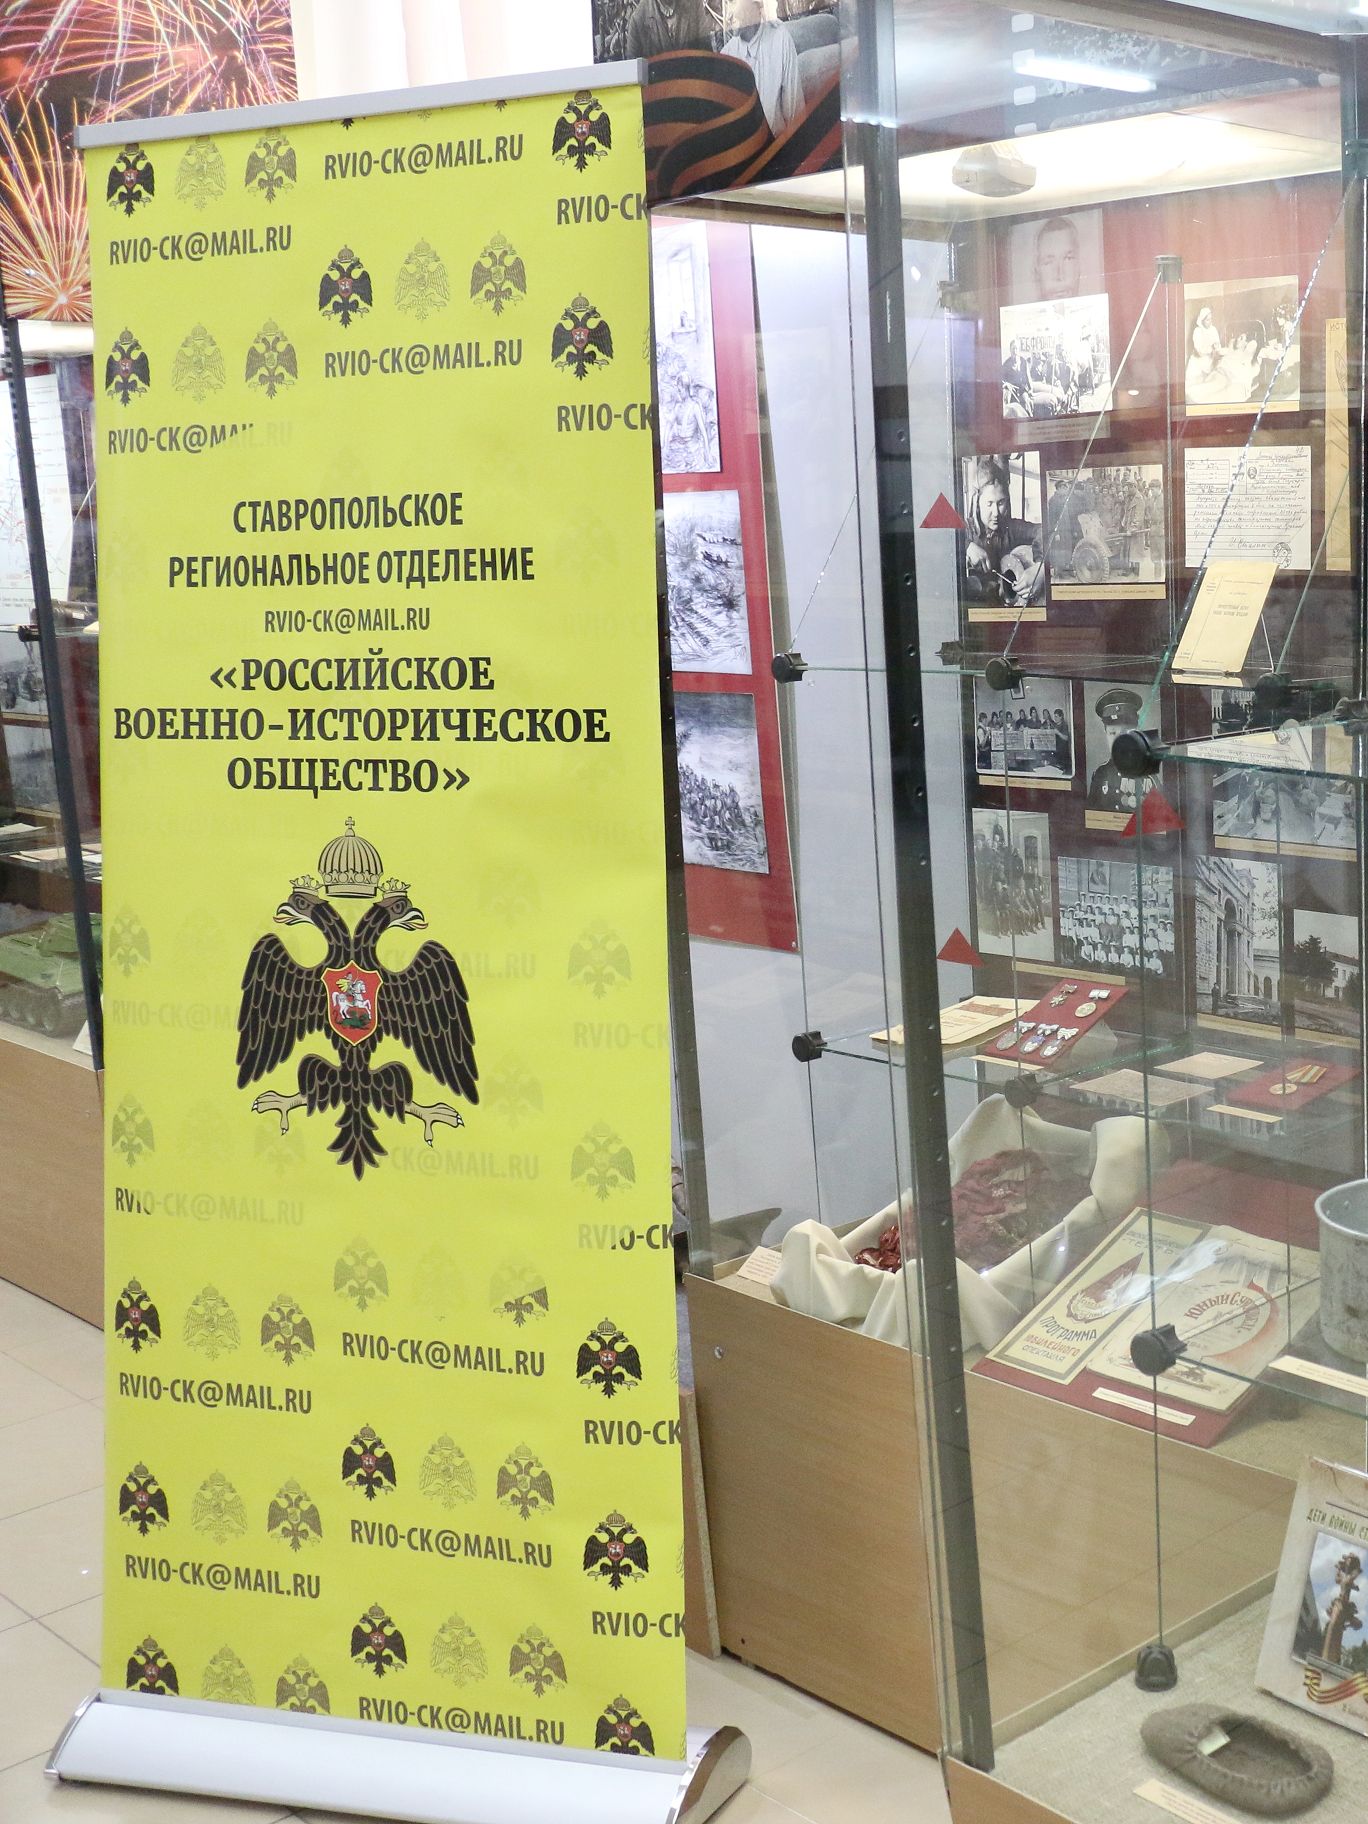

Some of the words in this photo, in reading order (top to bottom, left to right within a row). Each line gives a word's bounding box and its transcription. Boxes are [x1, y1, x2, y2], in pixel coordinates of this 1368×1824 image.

[324, 134, 524, 180] RVIO-CK@MAIL.RU
[109, 225, 292, 265] RVIO-CK@MAIL.RU
[324, 339, 523, 378] RVIO-CK@MAIL.RU
[233, 492, 463, 534] СТАВРОПОЛЬСКОЕ
[168, 551, 371, 588] РЕГИОНАЛЬНОЕ
[376, 547, 535, 589] ОТДЕЛЕНИЕ
[264, 607, 430, 635] RVIO-CK@MAIL.RU
[210, 648, 495, 692] «РОССИЙСКОЕ
[113, 707, 611, 743] ВОЕННО-ИСТОРИЧЕСКОЕ
[226, 756, 470, 800] ОБЩЕСТВО»
[1040, 1315, 1097, 1342] ПРОГРАММА
[342, 1331, 545, 1378] RVIO-CK@MAIL.RU
[119, 1372, 312, 1414] RVIO-CK@MAIL.RU
[1306, 1508, 1327, 1523] ДЕТИ
[1329, 1515, 1357, 1536] ВОЙНЫ
[350, 1519, 552, 1569] RVIO-CK@MAIL.RU
[125, 1554, 321, 1599] RVIO-CK@MAIL.RU
[358, 1696, 565, 1746] RVIO-CK@MAIL.RU
